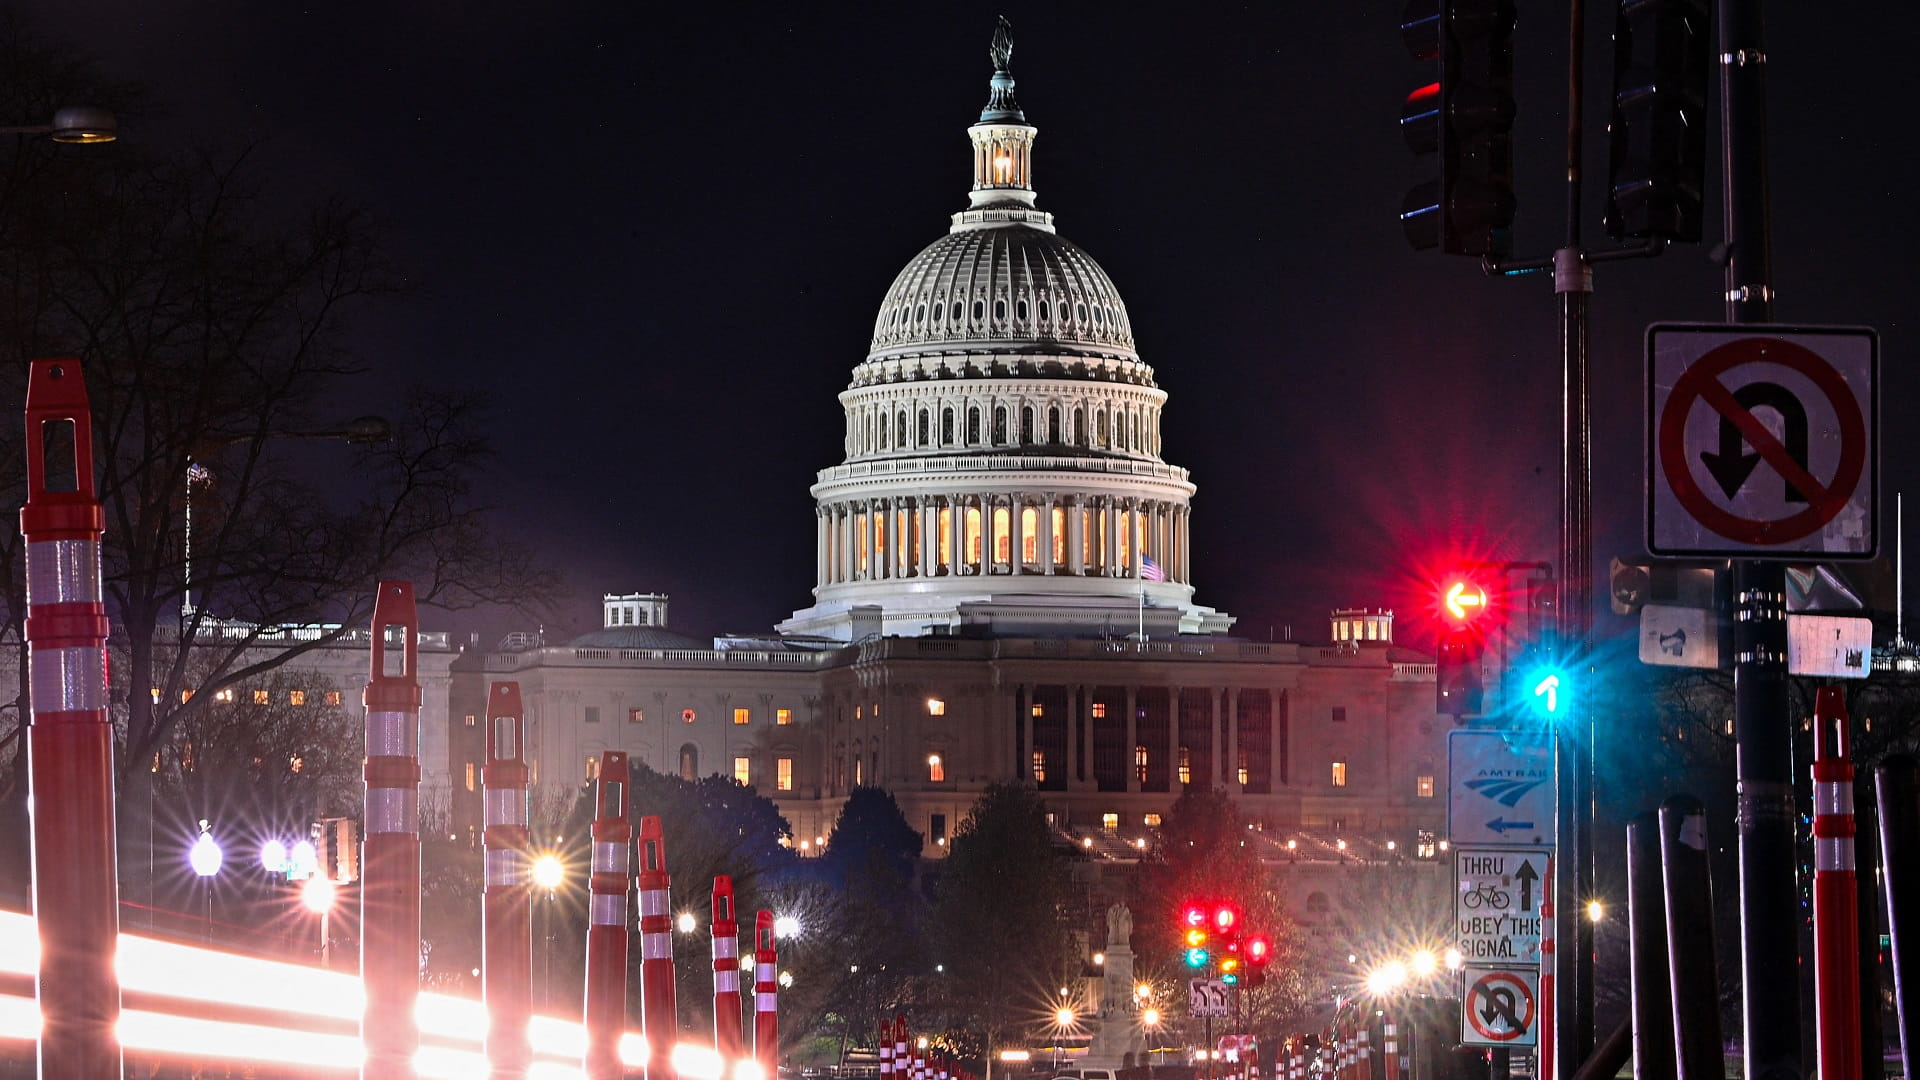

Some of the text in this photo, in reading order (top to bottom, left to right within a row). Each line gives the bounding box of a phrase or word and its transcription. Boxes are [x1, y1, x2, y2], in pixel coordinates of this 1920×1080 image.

[1478, 769, 1548, 777] AMTRAK
[1462, 857, 1504, 875] THRU
[1461, 940, 1517, 957] SIGNAL
